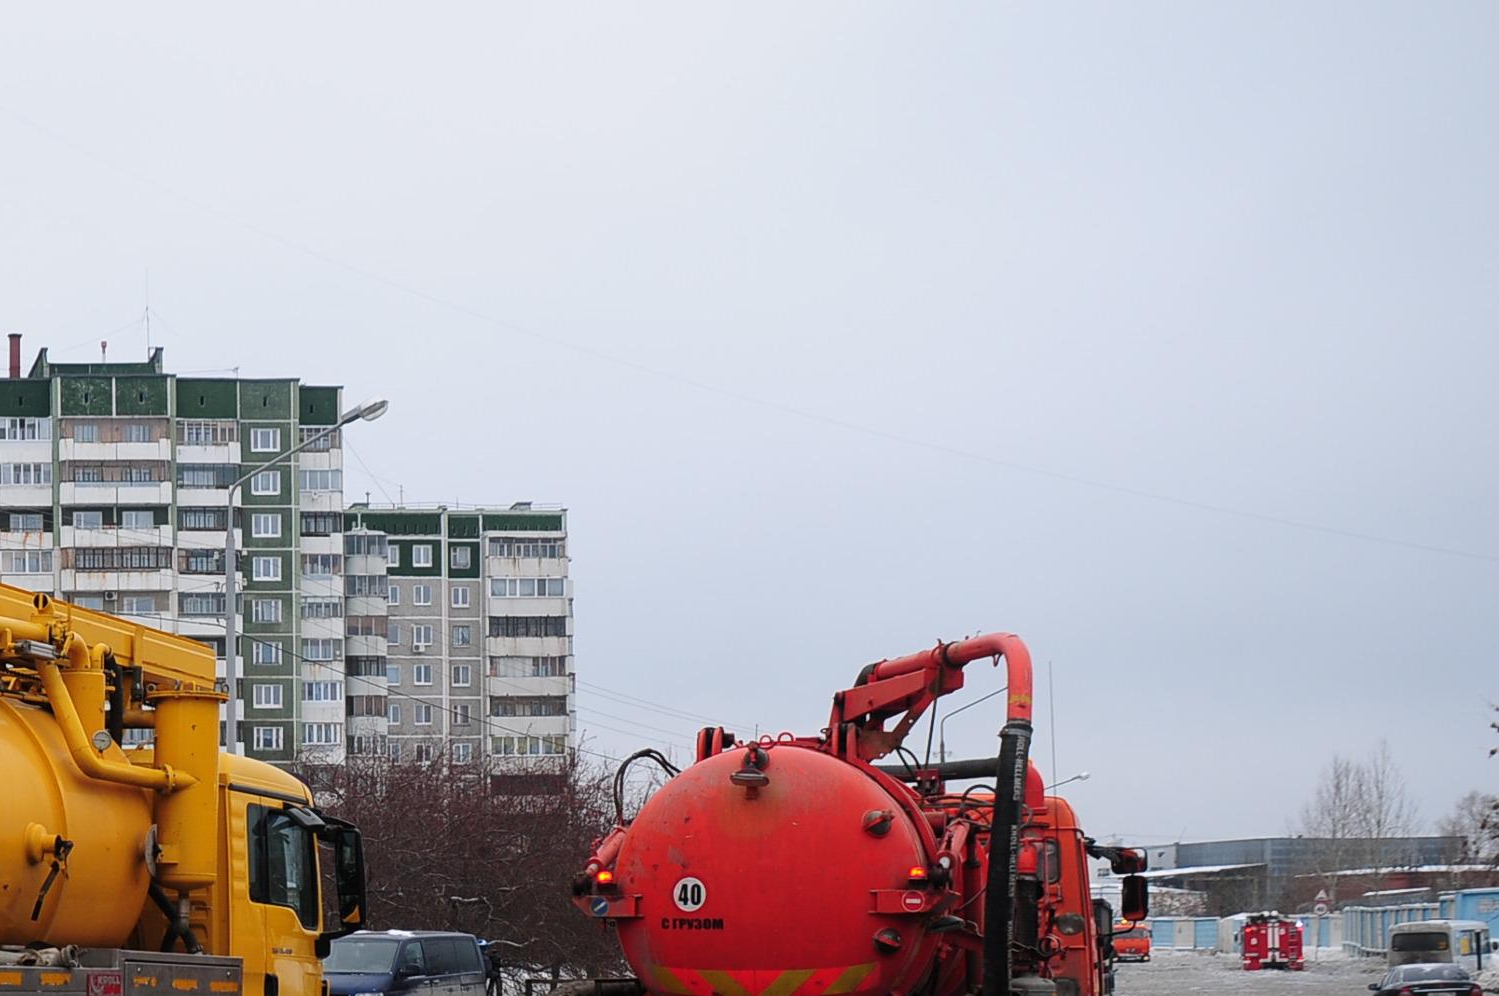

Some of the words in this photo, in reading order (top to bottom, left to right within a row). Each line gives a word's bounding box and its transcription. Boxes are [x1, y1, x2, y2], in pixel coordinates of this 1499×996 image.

[678, 883, 702, 906] 40
[661, 918, 670, 930] С
[672, 918, 724, 930] ГРУЗОМ
